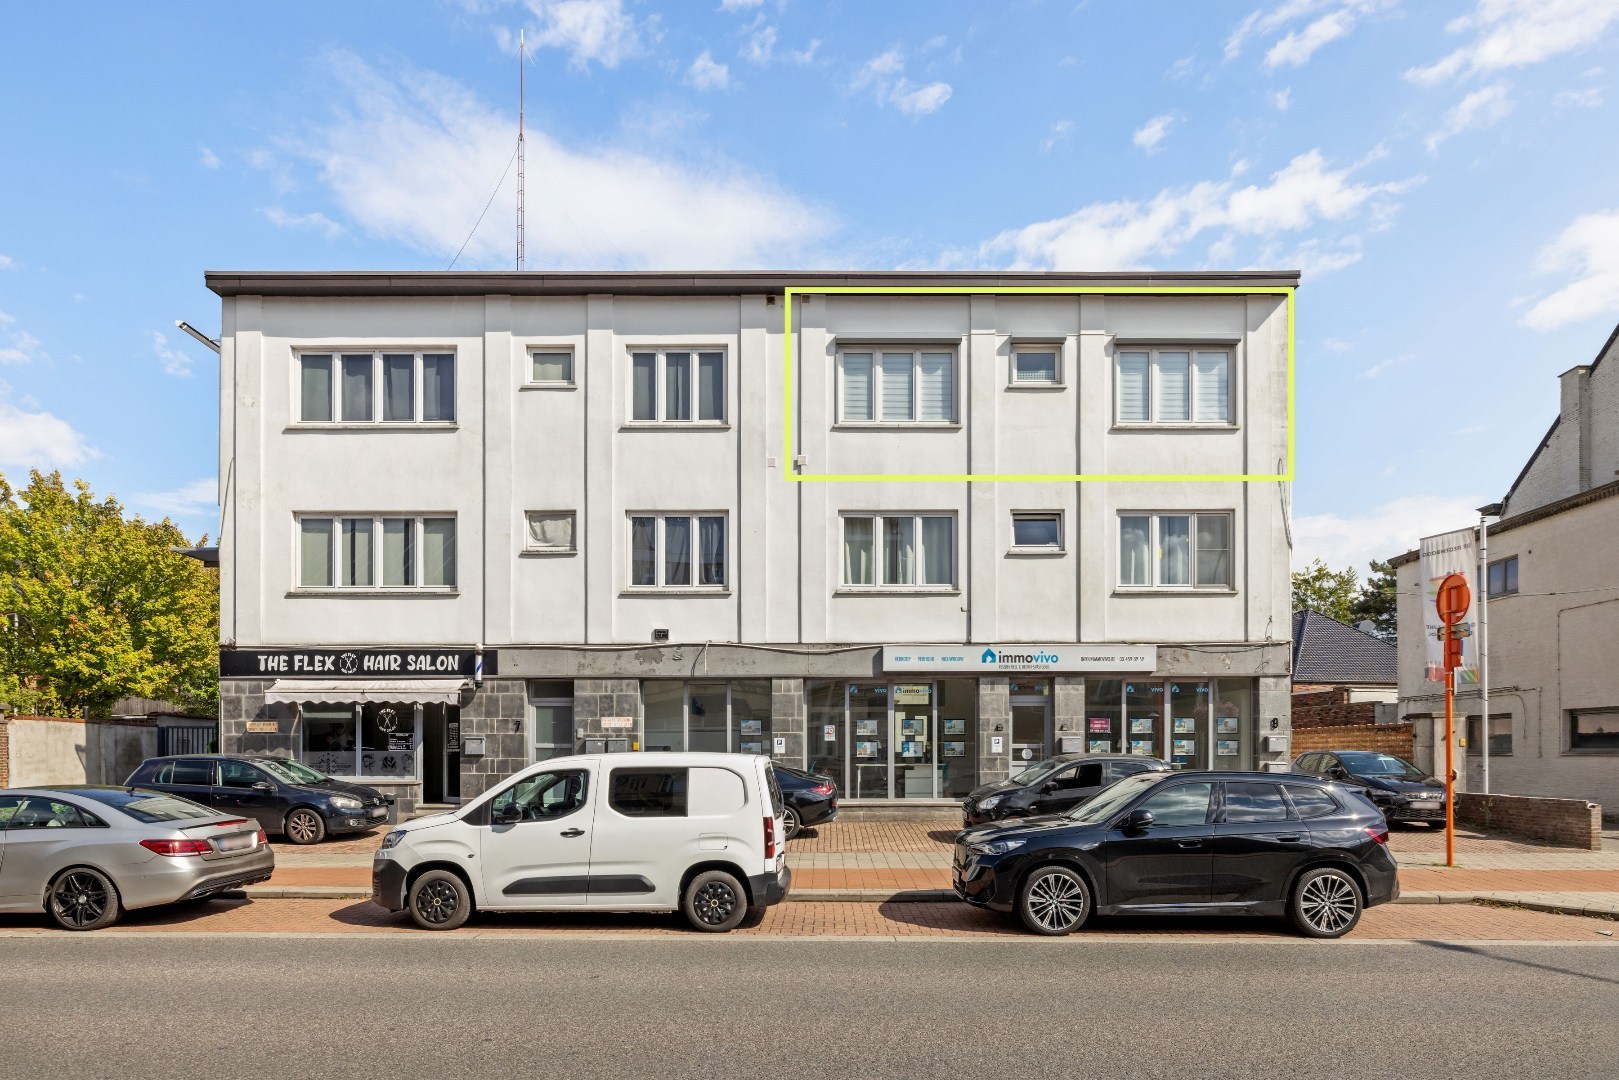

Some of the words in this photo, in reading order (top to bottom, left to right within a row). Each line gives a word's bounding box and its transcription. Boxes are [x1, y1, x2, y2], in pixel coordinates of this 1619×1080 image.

[258, 655, 288, 671] THE
[294, 655, 336, 671] FLEX
[364, 655, 401, 671] HAIR
[407, 655, 460, 671] SALON
[998, 651, 1059, 663] immovivo
[515, 720, 521, 732] 7
